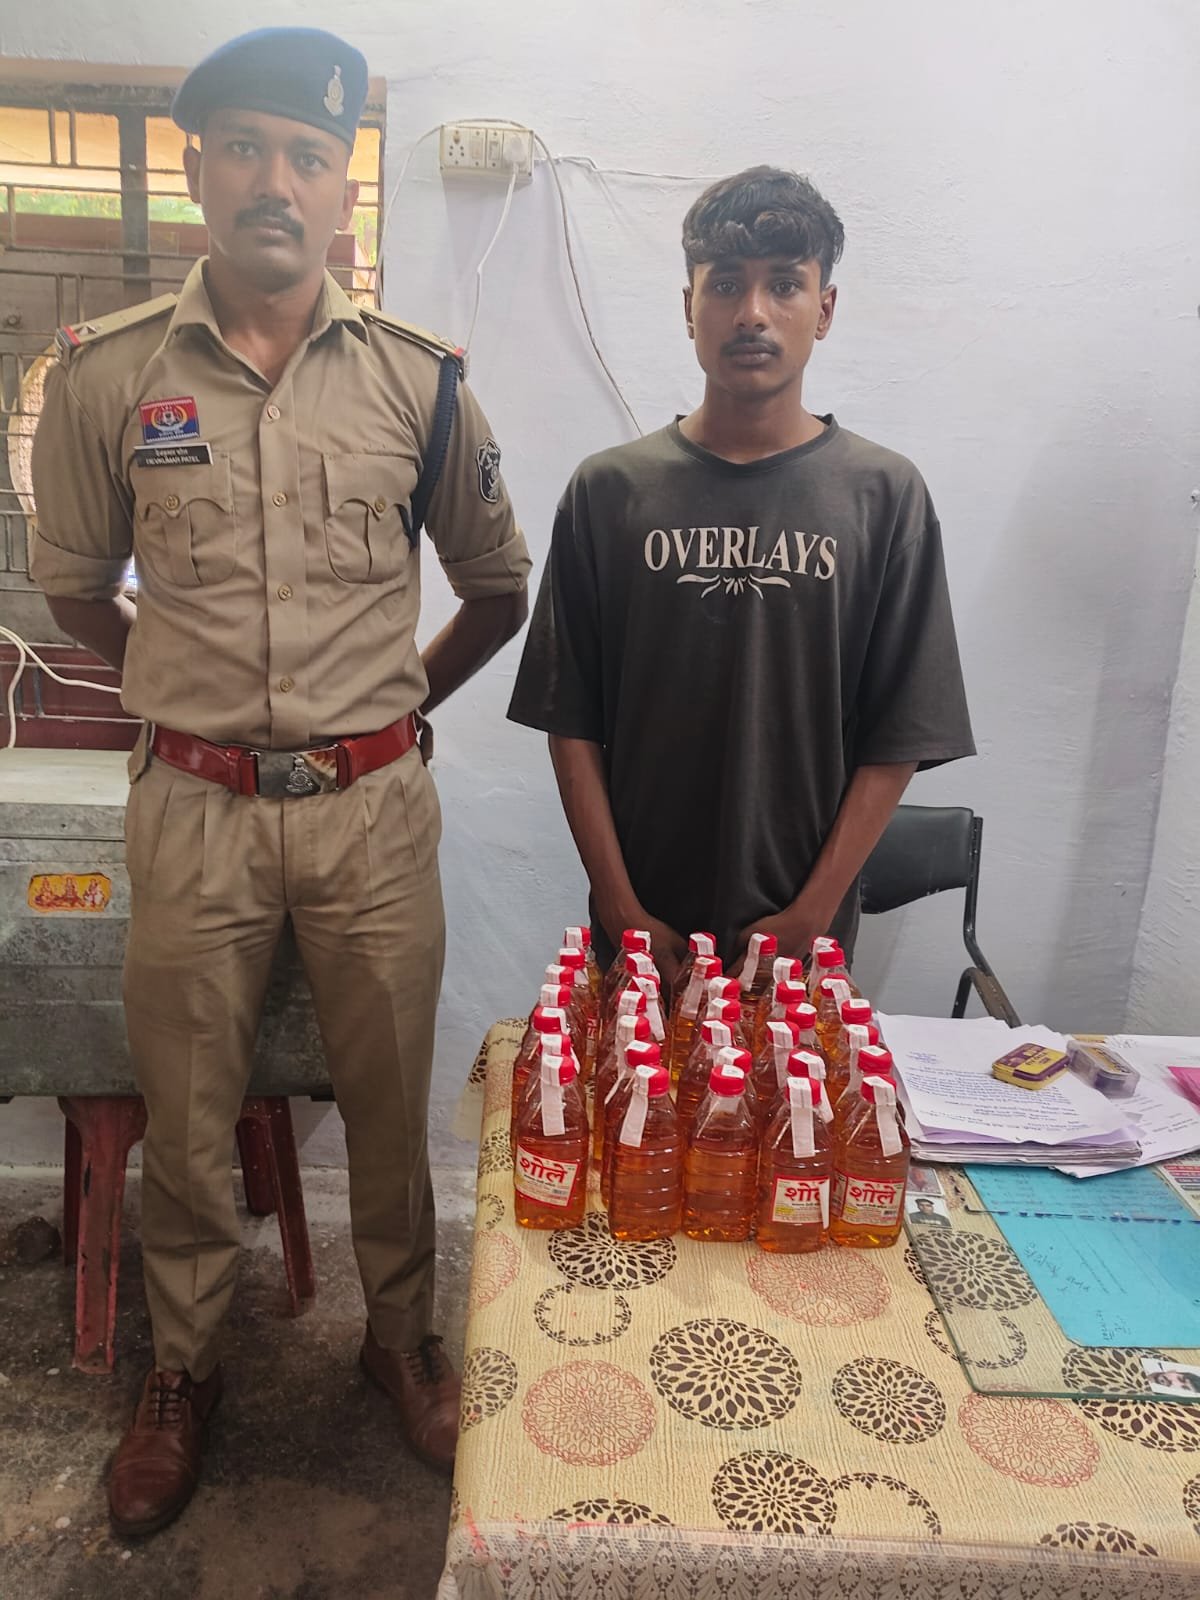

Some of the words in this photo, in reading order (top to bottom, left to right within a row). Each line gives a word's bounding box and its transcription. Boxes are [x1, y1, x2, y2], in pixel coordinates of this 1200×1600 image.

[644, 526, 838, 580] OVERLAYS
[519, 1156, 568, 1184] शोले
[849, 1183, 897, 1205] शोले
